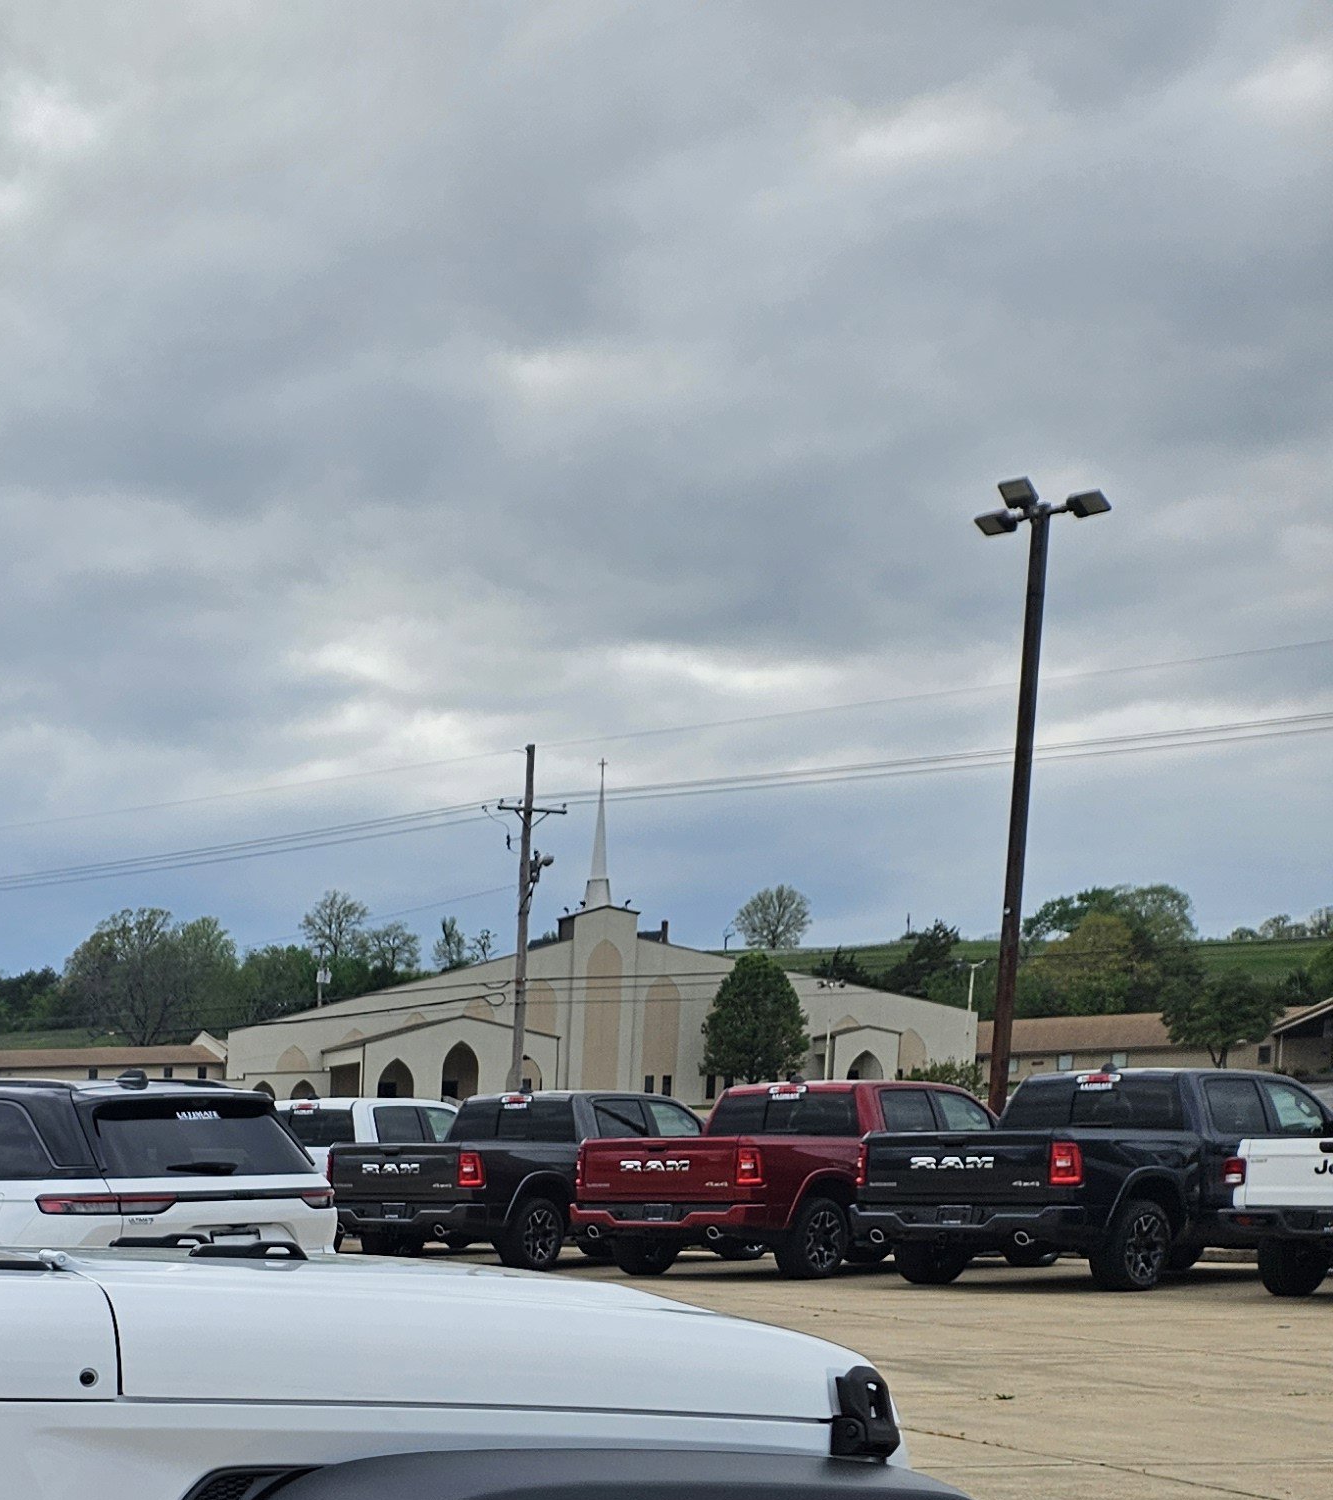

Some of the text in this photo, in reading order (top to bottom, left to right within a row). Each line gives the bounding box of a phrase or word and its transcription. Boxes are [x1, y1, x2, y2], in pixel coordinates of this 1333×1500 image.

[362, 1163, 421, 1175] RAM
[619, 1159, 690, 1172] RAM
[910, 1156, 995, 1170] RAM
